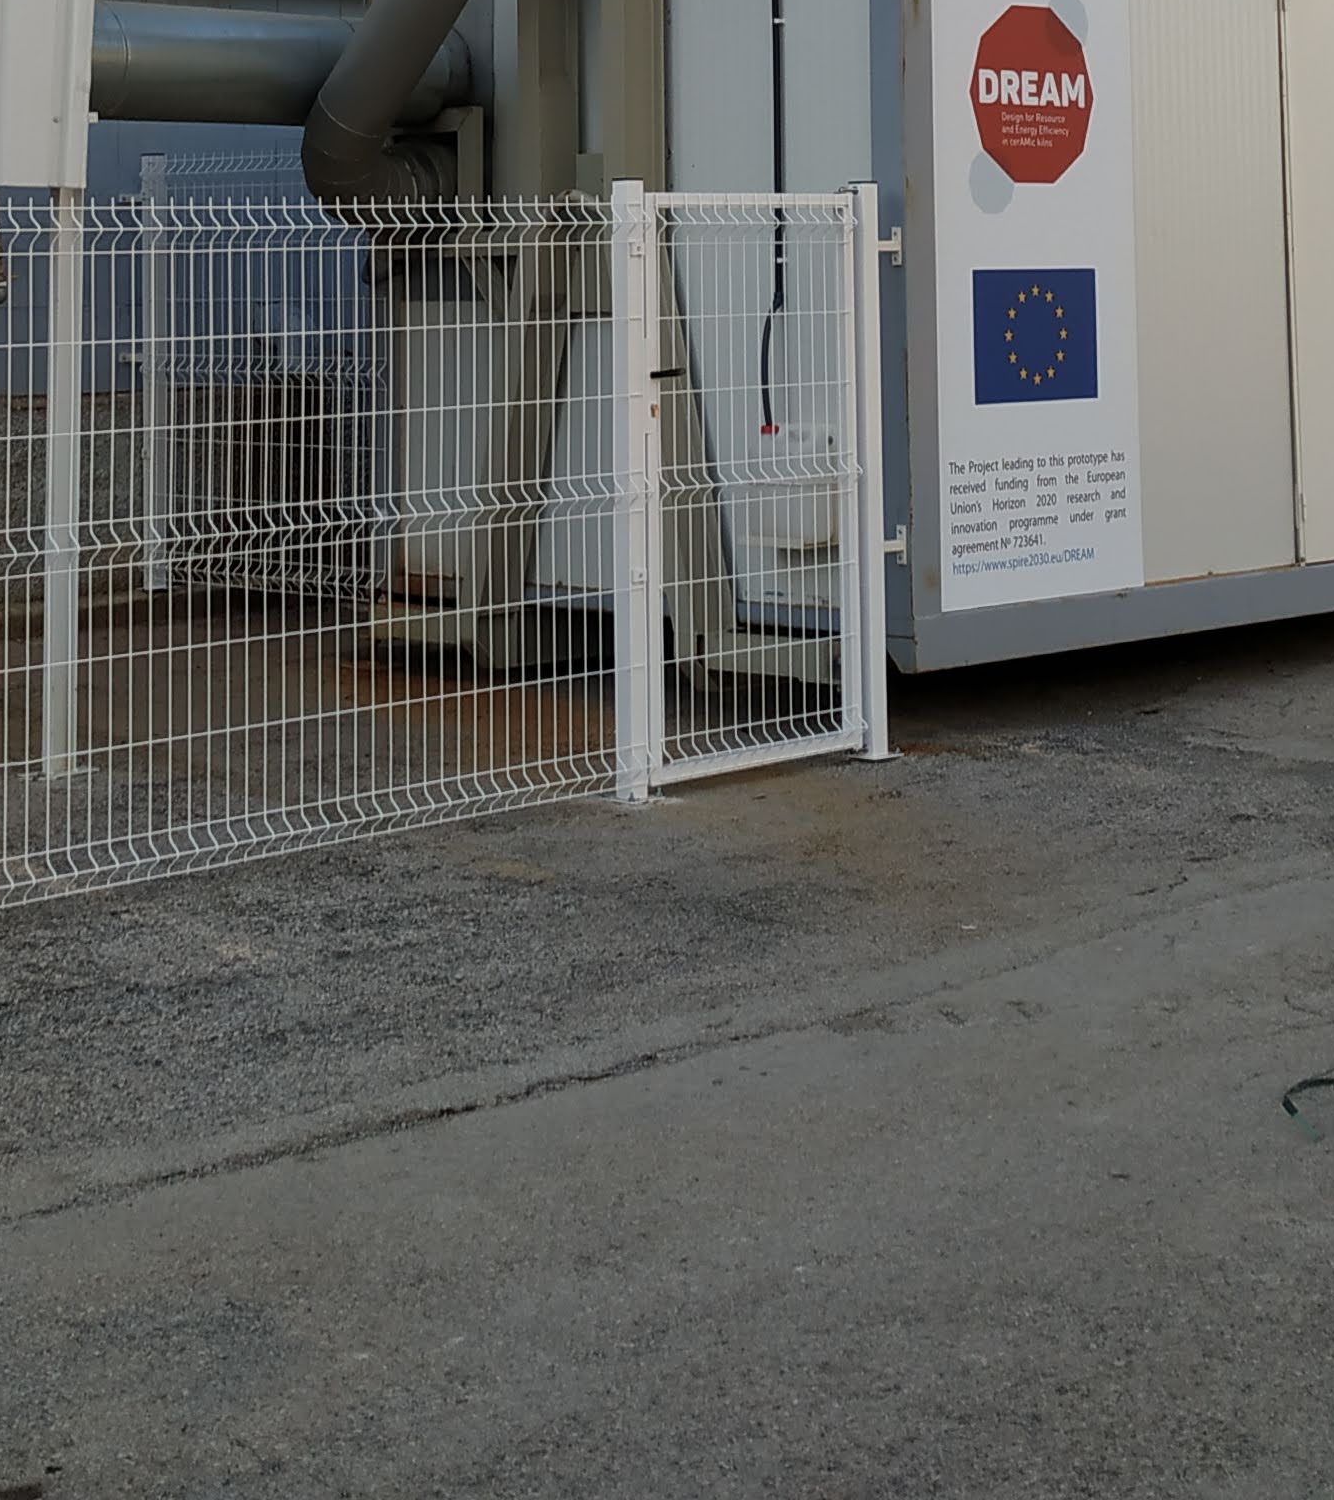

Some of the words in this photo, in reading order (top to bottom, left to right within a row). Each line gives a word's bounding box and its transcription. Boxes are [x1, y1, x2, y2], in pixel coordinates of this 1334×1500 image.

[978, 68, 1086, 109] DREAM
[1001, 111, 1024, 123] Design
[1025, 112, 1034, 122] for
[1035, 113, 1066, 123] Resource
[1002, 125, 1014, 133] and
[1015, 124, 1038, 136] Energy
[1039, 125, 1069, 138] Efficiency
[1009, 137, 1036, 147] cerAMic
[1037, 137, 1053, 148] kilns
[948, 462, 965, 475] The
[968, 460, 999, 476] Project
[1002, 457, 1034, 471] leading
[1037, 457, 1046, 468] to
[1049, 454, 1064, 467] this
[1068, 453, 1108, 468] prototype
[1111, 450, 1125, 461] has
[949, 480, 986, 495] received
[995, 477, 1028, 491] funding
[1037, 474, 1057, 487] from
[1065, 472, 1079, 485] the
[1087, 470, 1125, 484] European
[992, 498, 1026, 511] Horizon
[1036, 493, 1057, 507] 2020
[1067, 490, 1101, 504] research
[1111, 487, 1126, 500] and
[951, 520, 997, 535] innovation
[1009, 515, 1059, 532] programme
[1069, 510, 1094, 523] under
[1105, 508, 1127, 522] grant
[952, 540, 999, 558] agreement
[952, 548, 1095, 576] https://www.spire2030.eu/DREAM
